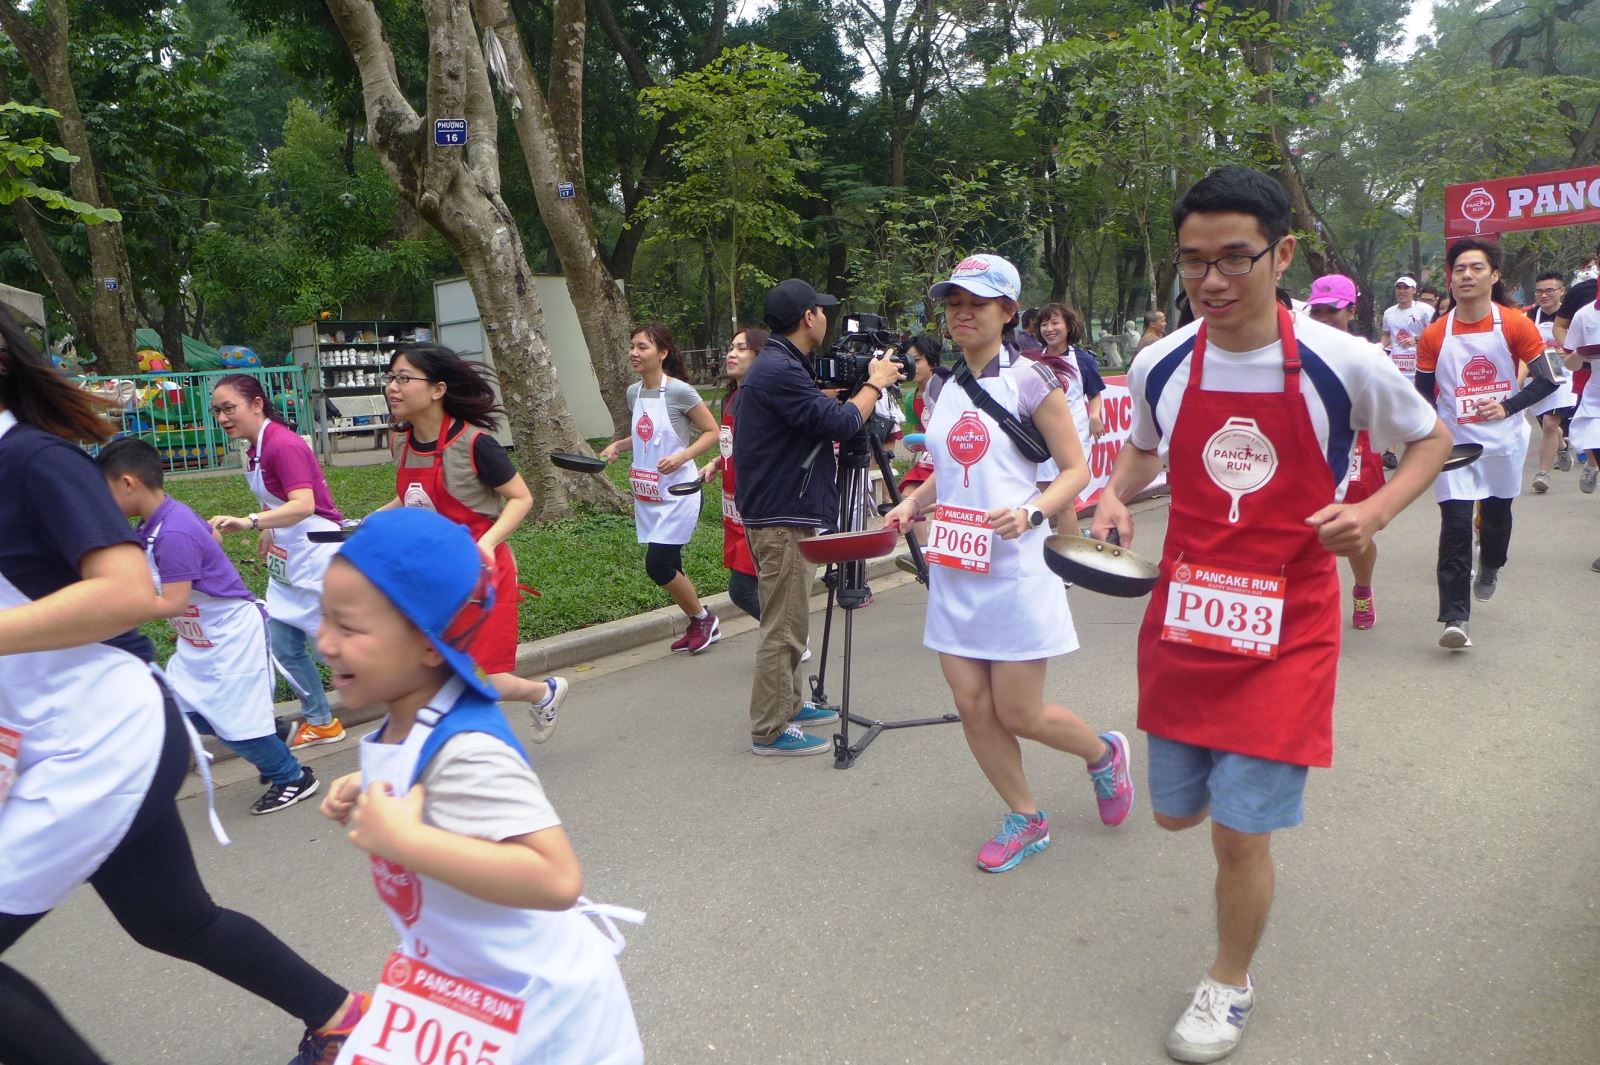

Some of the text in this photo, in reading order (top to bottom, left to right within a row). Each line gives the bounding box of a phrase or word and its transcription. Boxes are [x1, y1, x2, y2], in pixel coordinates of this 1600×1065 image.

[446, 134, 458, 142] 16
[1467, 385, 1495, 393] PANCAKE
[1092, 440, 1121, 478] UN
[1227, 461, 1252, 471] RUN
[632, 480, 659, 496] P056
[945, 509, 975, 522] PANCAKE
[932, 525, 988, 557] P066
[269, 555, 286, 577] 257
[1195, 569, 1279, 592] PANCAKE RUN
[1174, 590, 1273, 637] P033
[414, 968, 482, 1008] PANCAKE
[483, 993, 515, 1021] RUN
